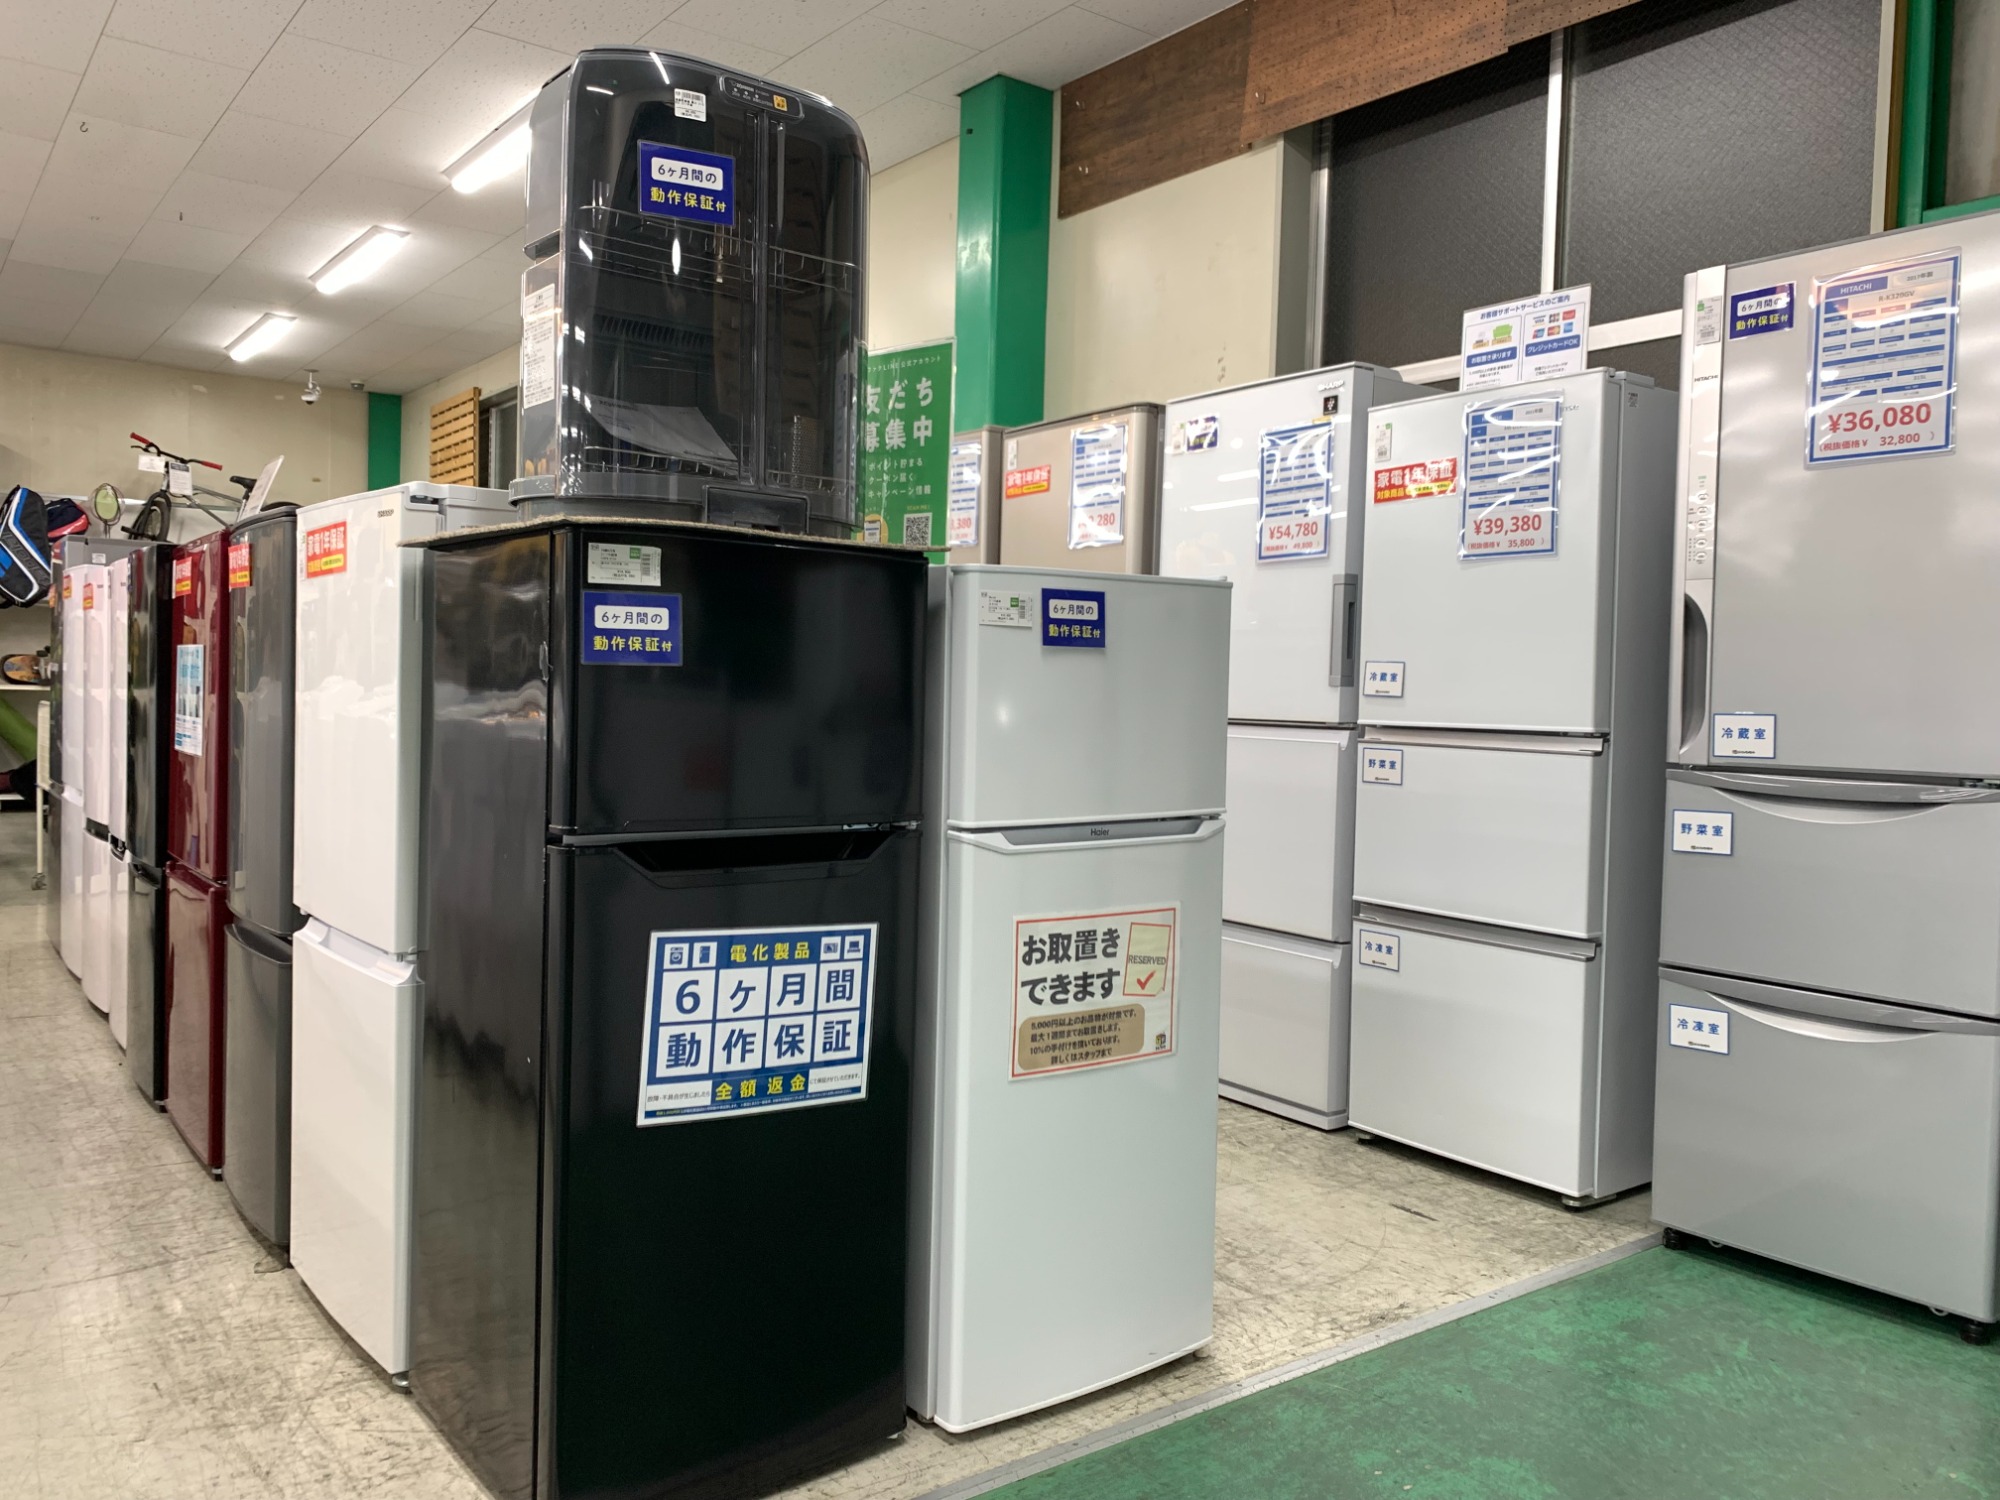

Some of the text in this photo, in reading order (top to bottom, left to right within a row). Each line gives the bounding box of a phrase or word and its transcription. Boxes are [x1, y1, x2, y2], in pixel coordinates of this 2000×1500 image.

[650, 187, 726, 212] 動作保証付
[1840, 283, 1872, 294] HITACHI
[1736, 314, 1788, 331] 動作保証付
[1528, 338, 1579, 354] クレジットカードOK
[1828, 403, 1931, 433] ¥36,080
[1880, 433, 1920, 446] 32,800
[1269, 521, 1318, 540] ¥54,780
[1473, 514, 1542, 536] ¥39,380
[1508, 538, 1535, 548] 35,800
[1048, 624, 1101, 639] 動作保証付
[593, 636, 673, 652] 動作保証付
[1369, 672, 1398, 682] 冷蔵室
[1721, 727, 1766, 740] 冷蔵室
[1368, 759, 1397, 770] 野菜室
[1091, 827, 1110, 837] Haier
[1681, 823, 1723, 837] 野菜室
[730, 942, 810, 963] 電化製品
[1022, 928, 1120, 966] お取置き
[1365, 941, 1393, 955] 冷凍室
[1128, 955, 1167, 965] RESERVED
[1021, 968, 1120, 1006] できます
[1677, 1018, 1719, 1035] 冷凍室
[665, 1019, 852, 1069] 動作保証
[1051, 1048, 1112, 1065] 詳しくはスタッフまで
[715, 1073, 806, 1101] 全額返金
